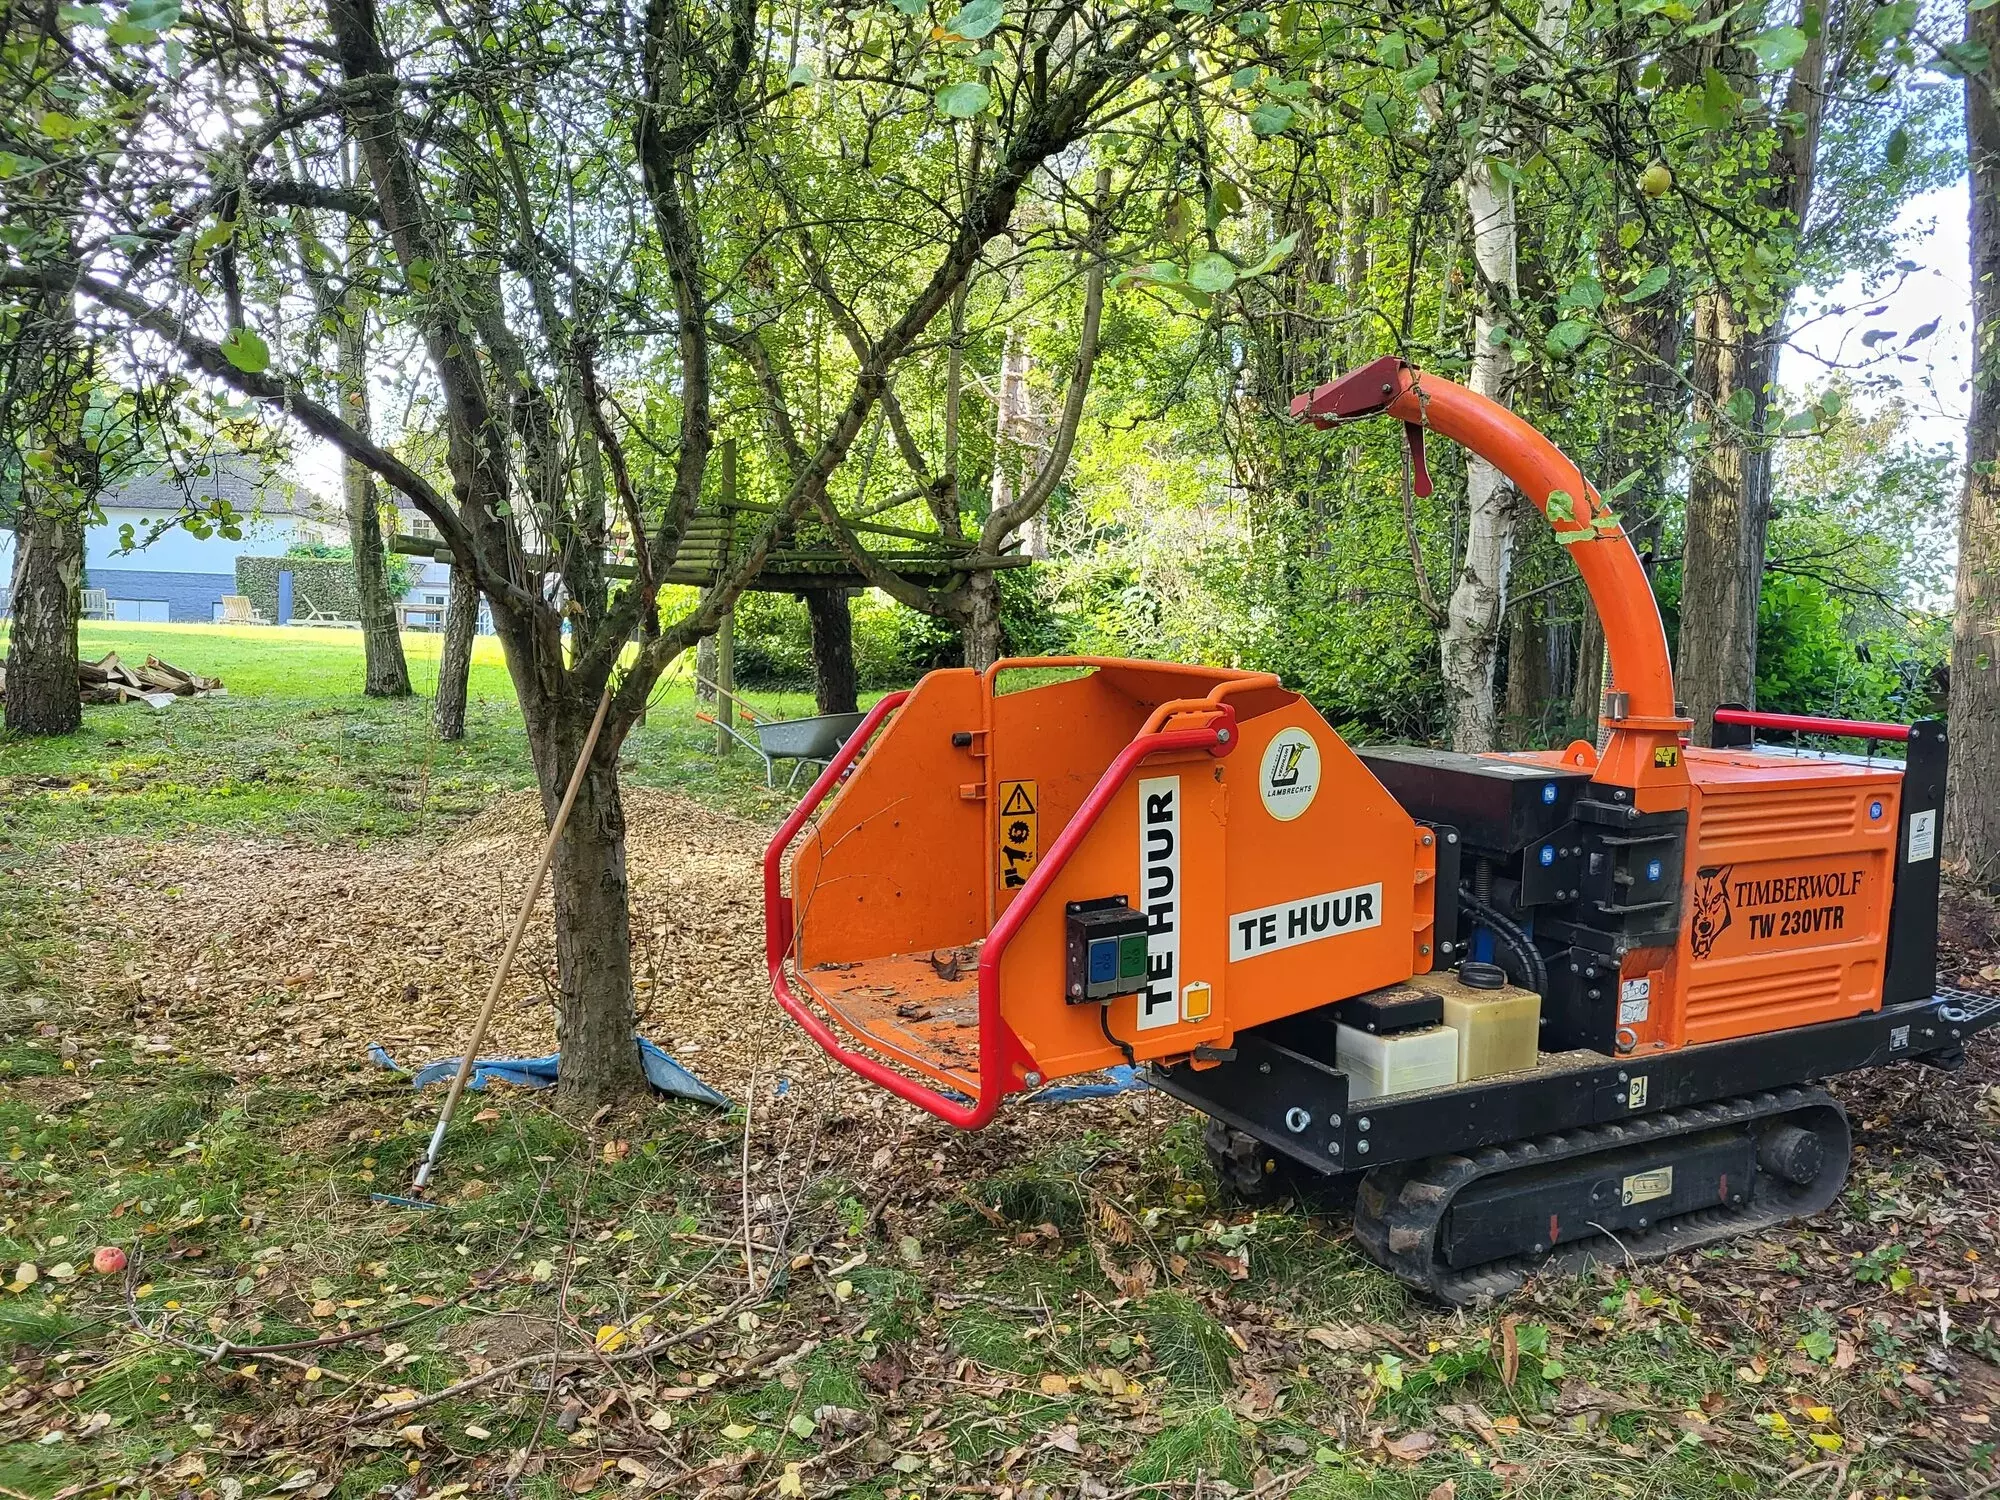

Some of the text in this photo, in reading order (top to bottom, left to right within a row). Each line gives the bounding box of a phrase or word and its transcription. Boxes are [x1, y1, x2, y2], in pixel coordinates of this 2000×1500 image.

[1267, 784, 1312, 797] LAMBRECHTS
[1145, 789, 1174, 1015] TE HUUR
[1734, 870, 1864, 908] TIMBERWOLF
[1238, 892, 1374, 951] TE HUUR
[1749, 905, 1844, 940] TW 230VTR
